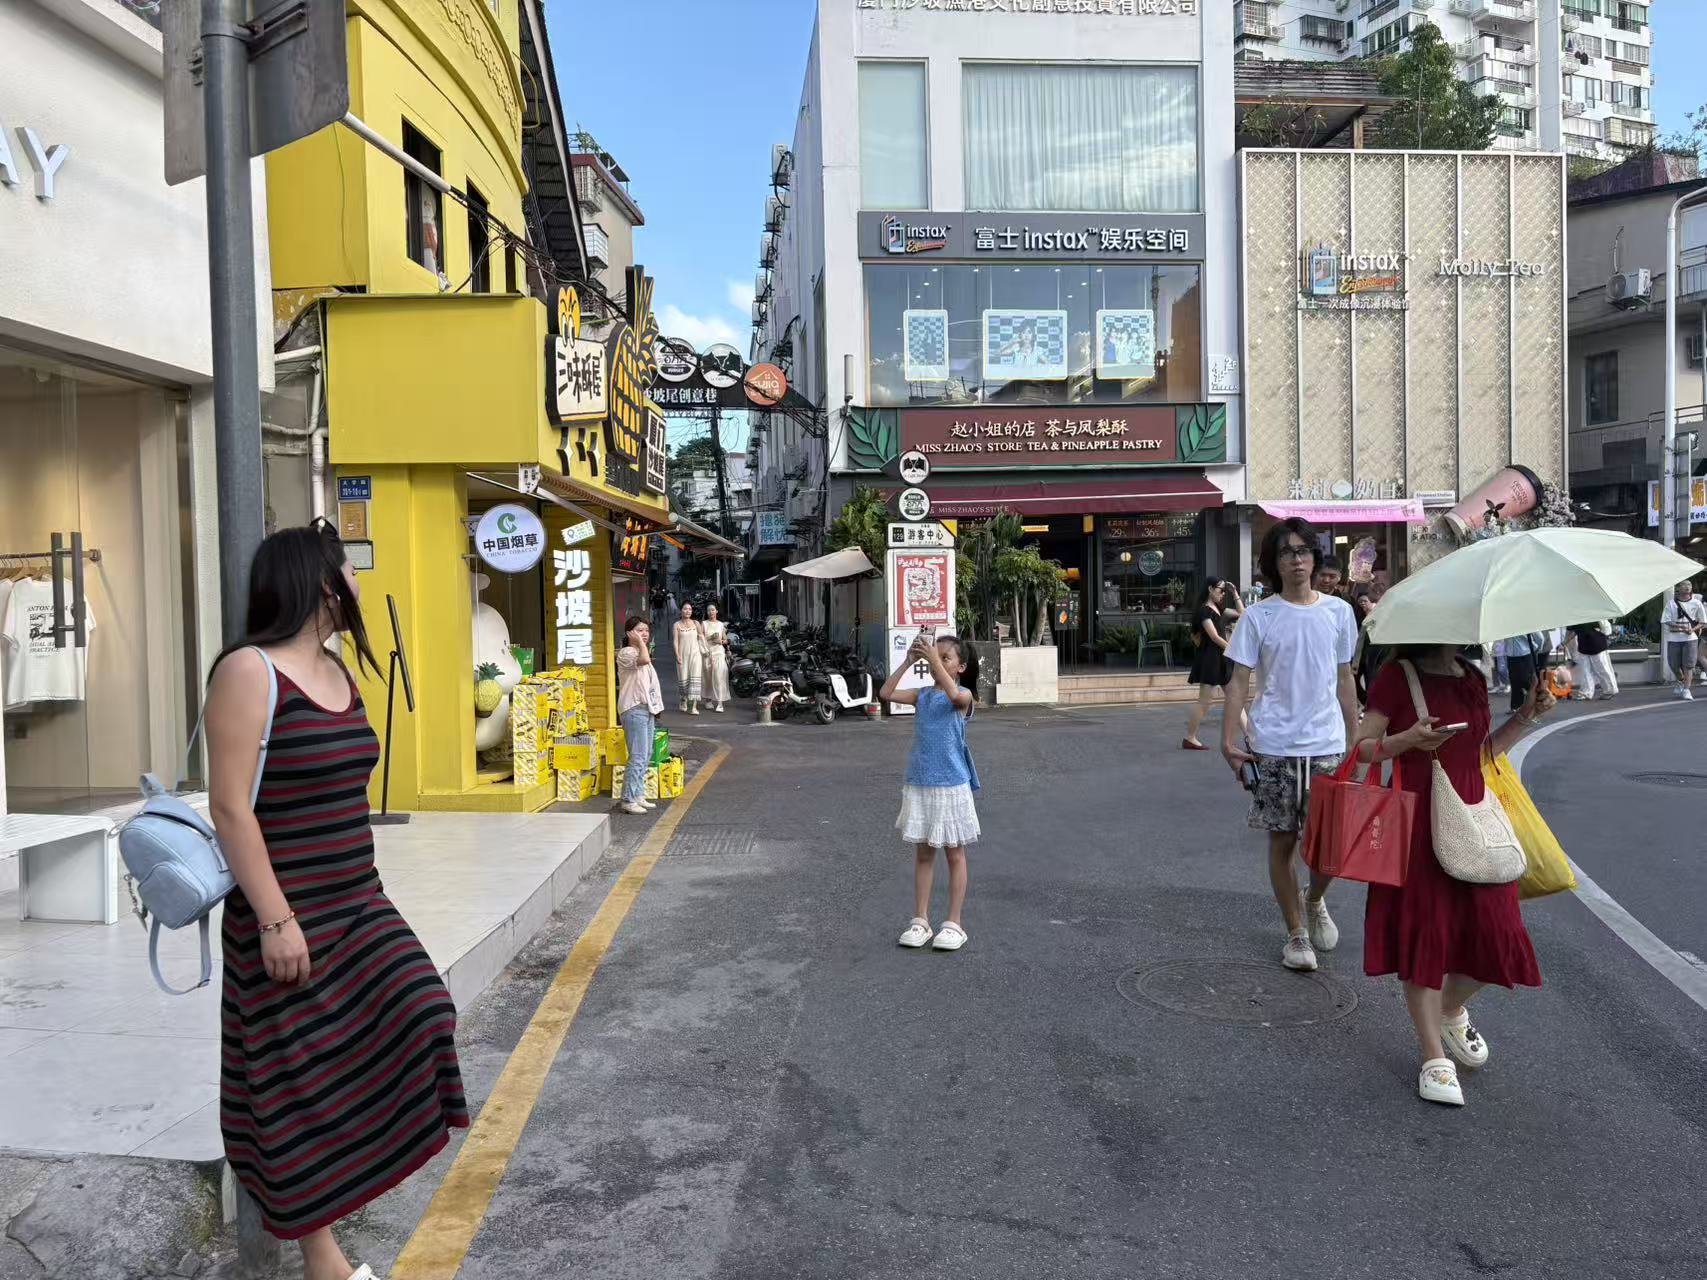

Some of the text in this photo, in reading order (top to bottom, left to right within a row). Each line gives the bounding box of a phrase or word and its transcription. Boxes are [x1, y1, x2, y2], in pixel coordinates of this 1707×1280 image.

[975, 226, 1020, 250] 富士
[1101, 228, 1189, 251] 娱乐空间
[1438, 258, 1499, 279] Molly
[950, 418, 1130, 438] 赵小姐的店 茶与凤梨酥
[915, 439, 1163, 453] MISS ZHAO'S STORE TEA & PINEAPPLE PASTRY
[483, 533, 539, 553] 中国烟草
[907, 529, 944, 541] 游客中心
[552, 549, 593, 665] 沙坡尾
